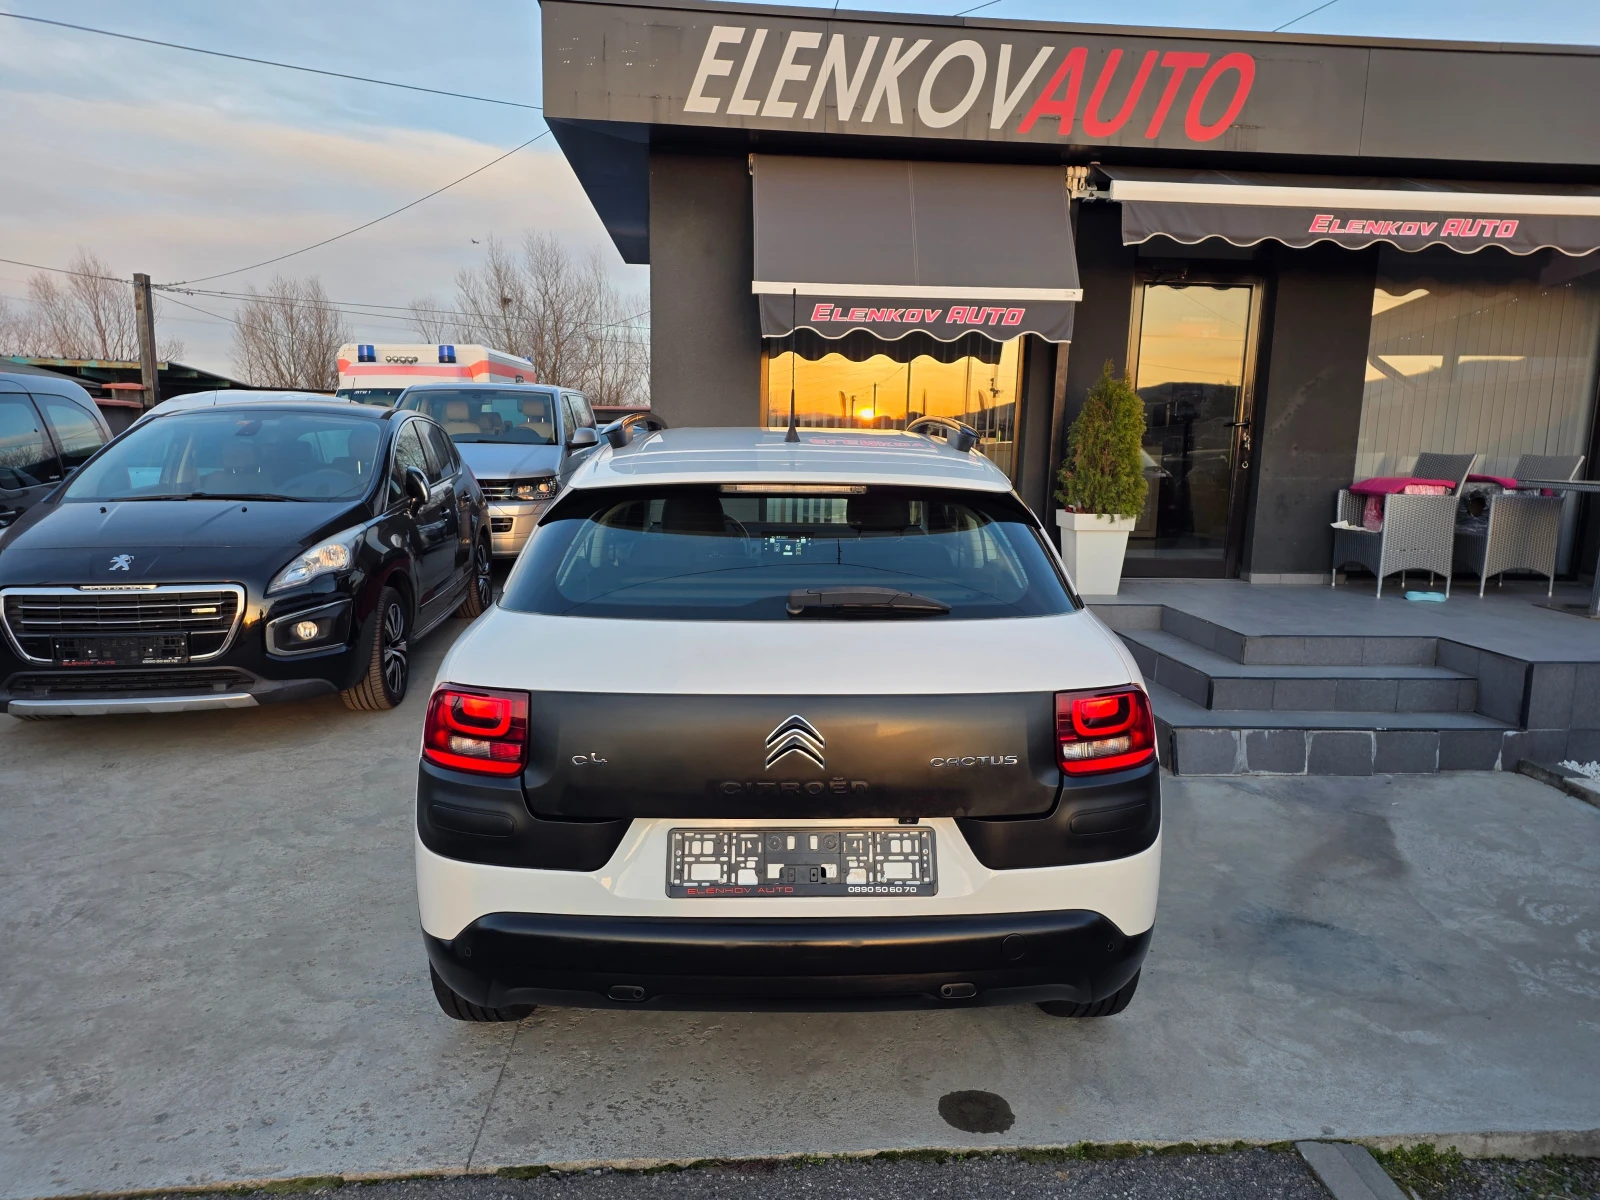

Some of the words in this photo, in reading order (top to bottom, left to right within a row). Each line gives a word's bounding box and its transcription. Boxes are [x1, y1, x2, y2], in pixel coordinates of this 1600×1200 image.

[1440, 218, 1520, 238] AUTO
[945, 305, 1026, 326] AUTO
[929, 755, 1019, 768] CACTUS
[757, 886, 794, 894] AUTO
